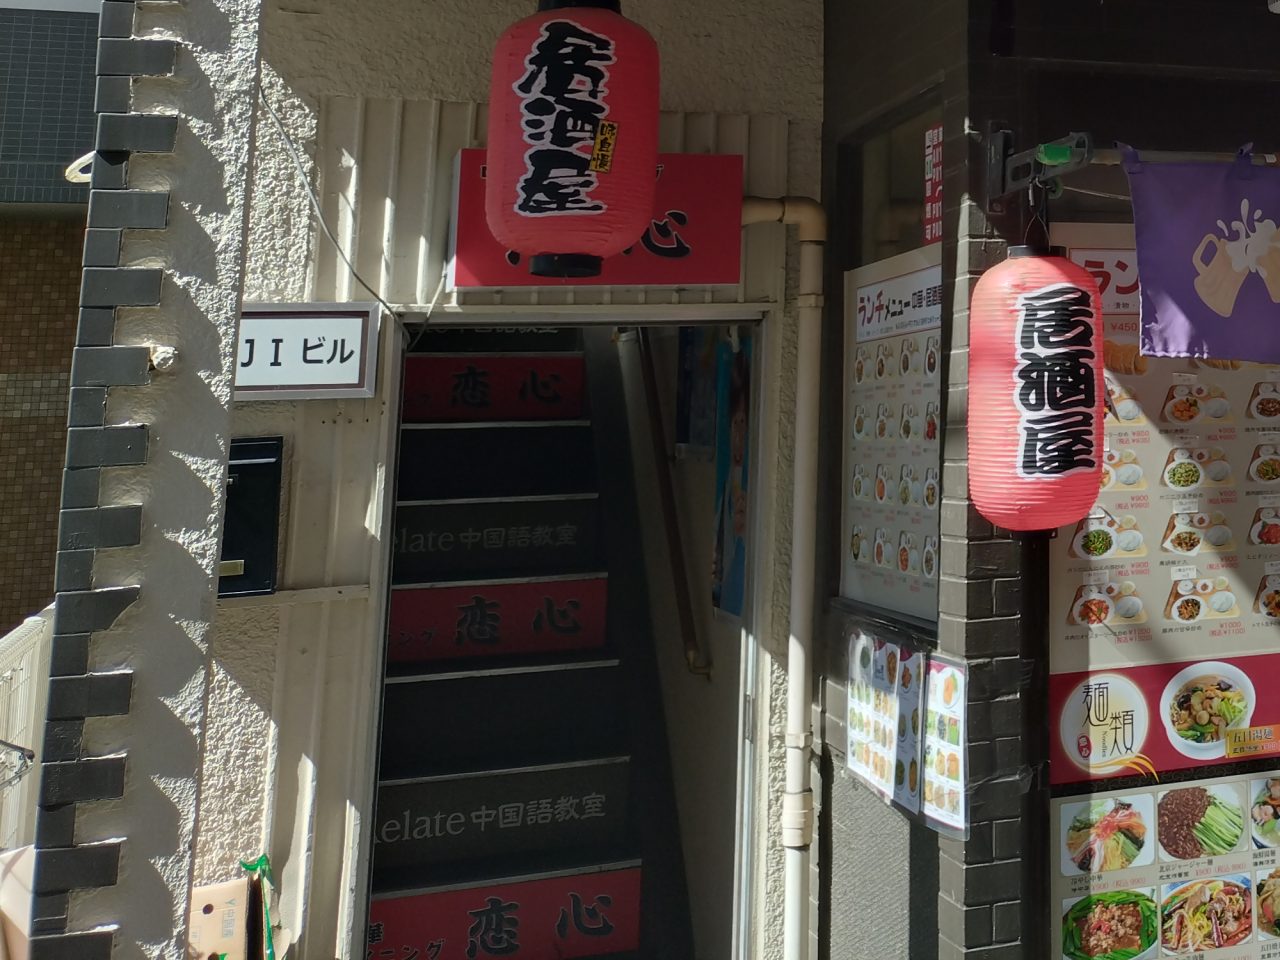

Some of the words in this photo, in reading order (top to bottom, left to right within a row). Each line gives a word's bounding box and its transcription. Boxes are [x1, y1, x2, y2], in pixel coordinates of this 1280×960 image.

[513, 19, 615, 216] 居酒屋
[1016, 283, 1095, 478] 居酒屋
[459, 526, 577, 550] 中国語教室
[456, 595, 581, 646] 恋心
[375, 809, 466, 844] elate
[470, 792, 606, 832] 中国語教室
[466, 892, 614, 958] 恋心
